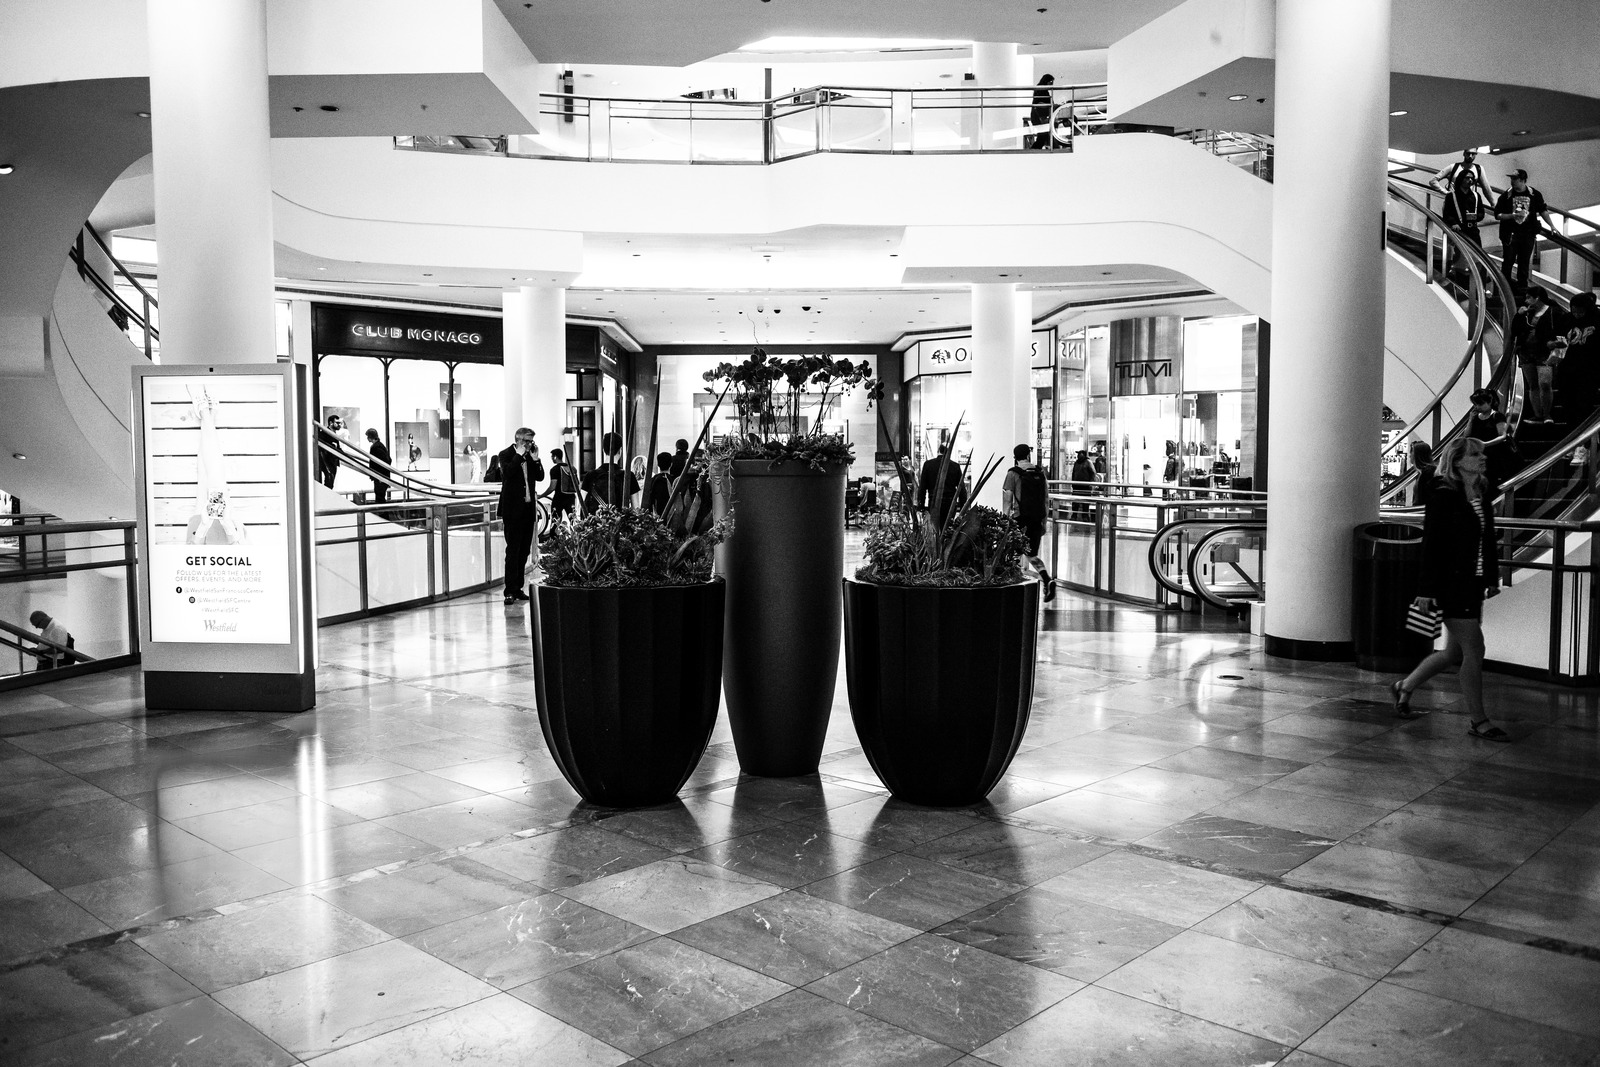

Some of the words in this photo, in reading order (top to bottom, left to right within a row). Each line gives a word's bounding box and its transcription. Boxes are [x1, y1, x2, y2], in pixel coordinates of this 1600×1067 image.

[352, 323, 402, 339] CLUB
[407, 328, 481, 345] MONACO
[1115, 359, 1172, 379] TUMI
[185, 556, 207, 566] GET
[210, 556, 252, 566] SOCIAL
[203, 619, 238, 632] Westfield
